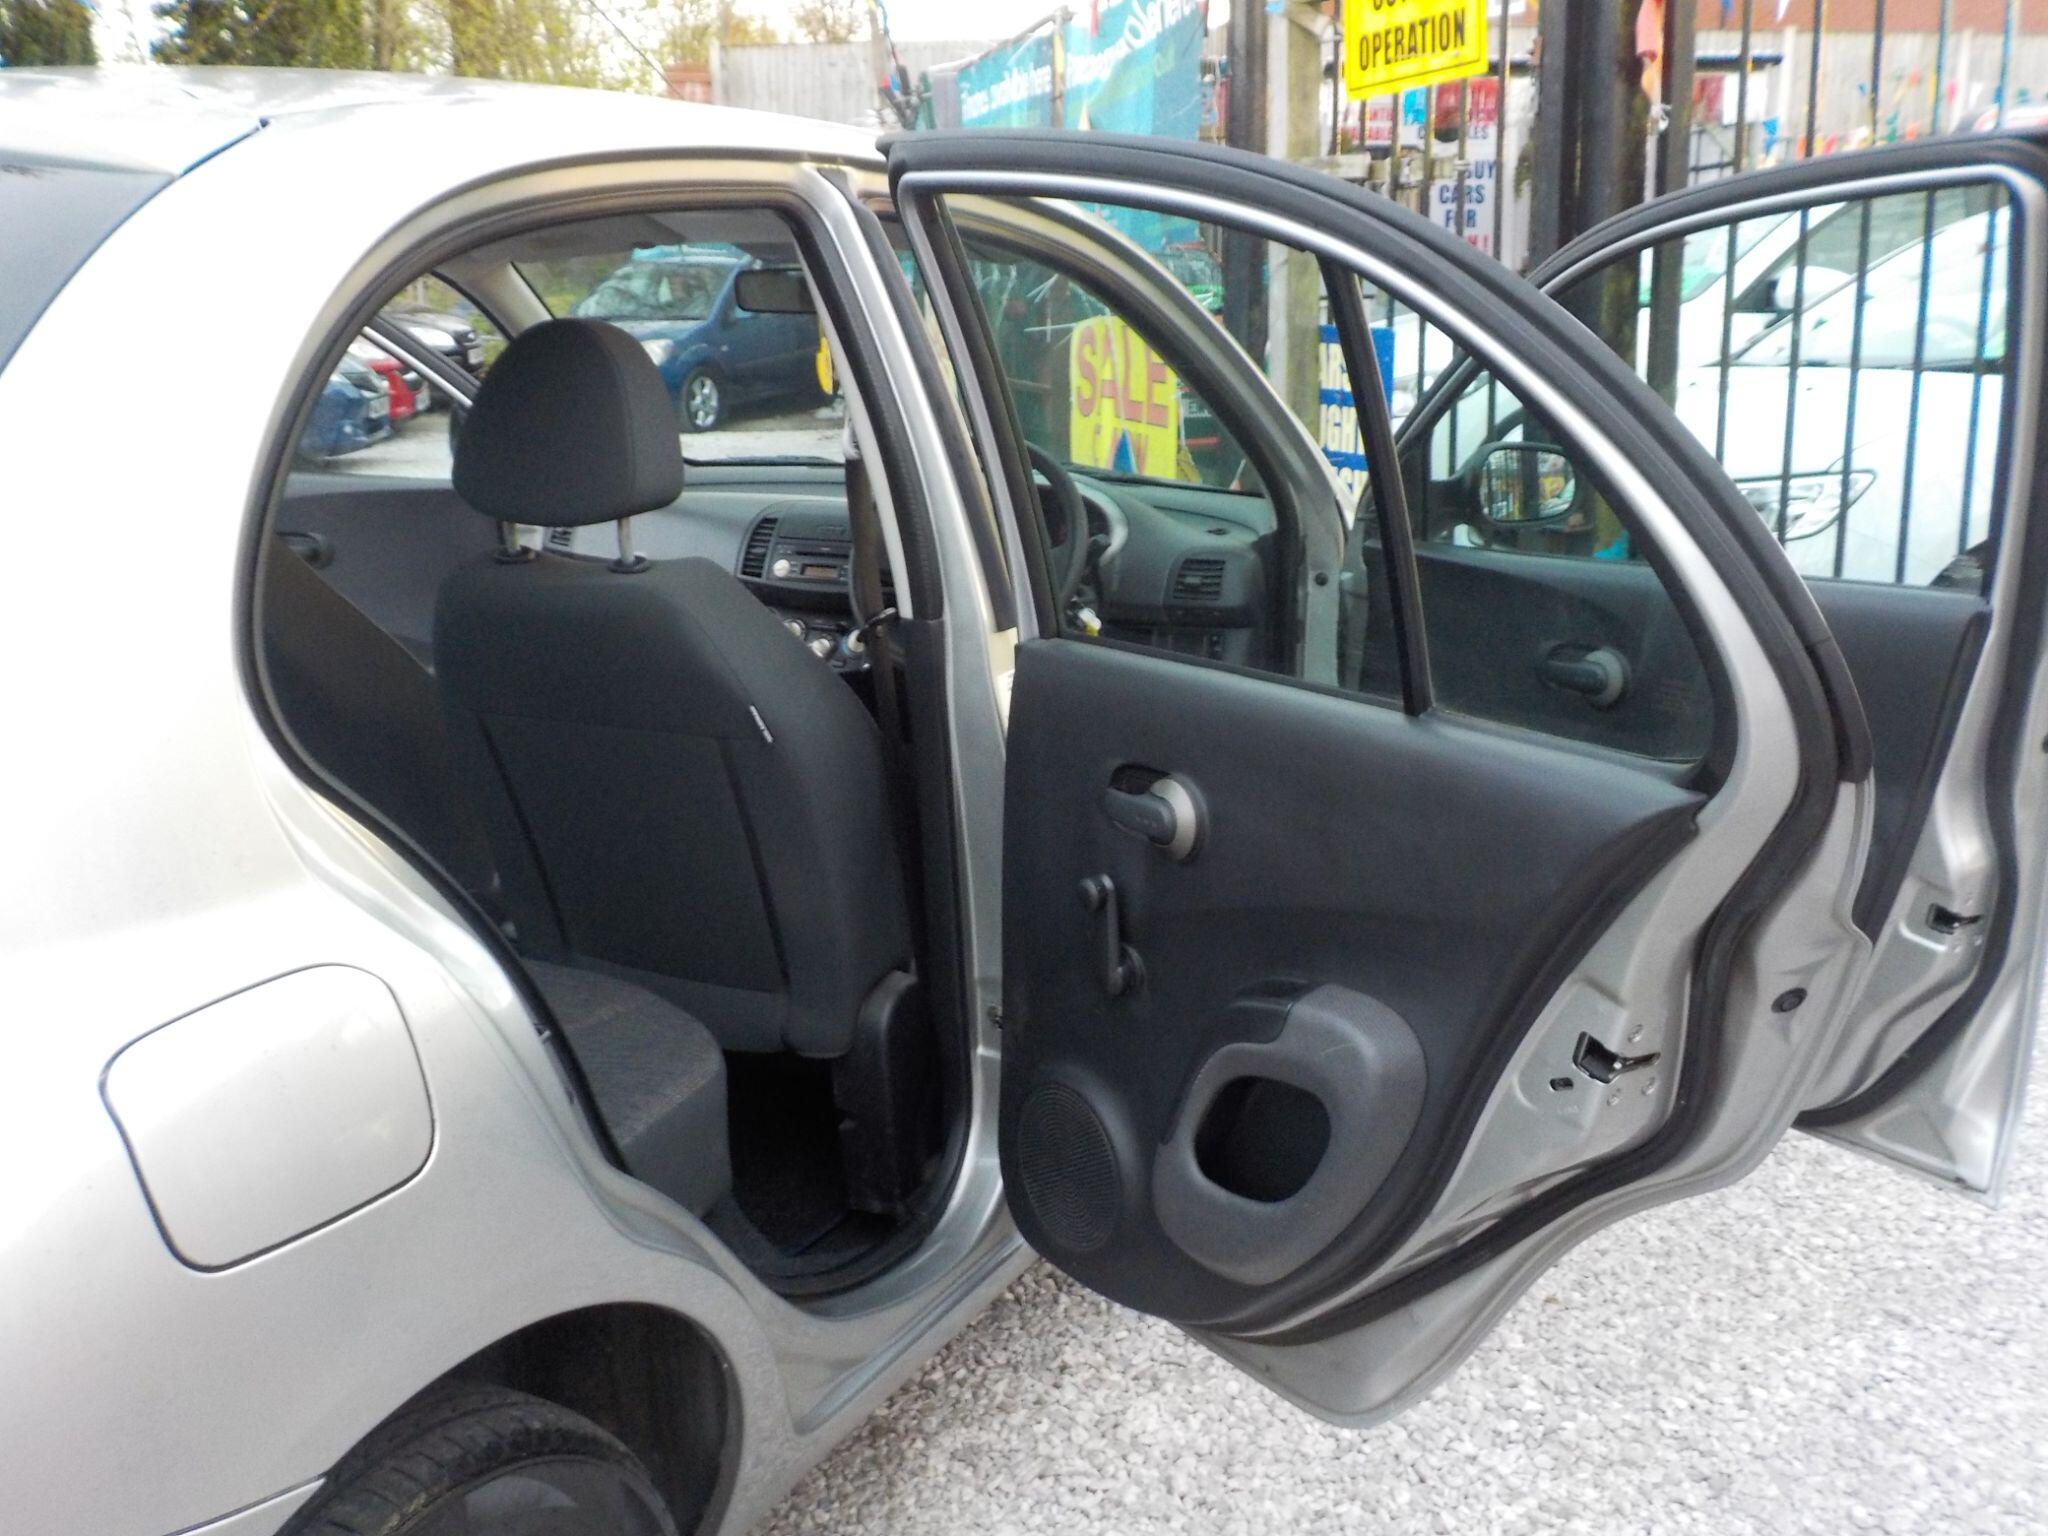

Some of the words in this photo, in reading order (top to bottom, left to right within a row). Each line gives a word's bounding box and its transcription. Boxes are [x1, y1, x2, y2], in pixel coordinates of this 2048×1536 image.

[1359, 7, 1466, 71] OPERATION
[1439, 184, 1486, 204] CARS
[1445, 209, 1476, 228] FR
[1077, 325, 1169, 428] SALE
